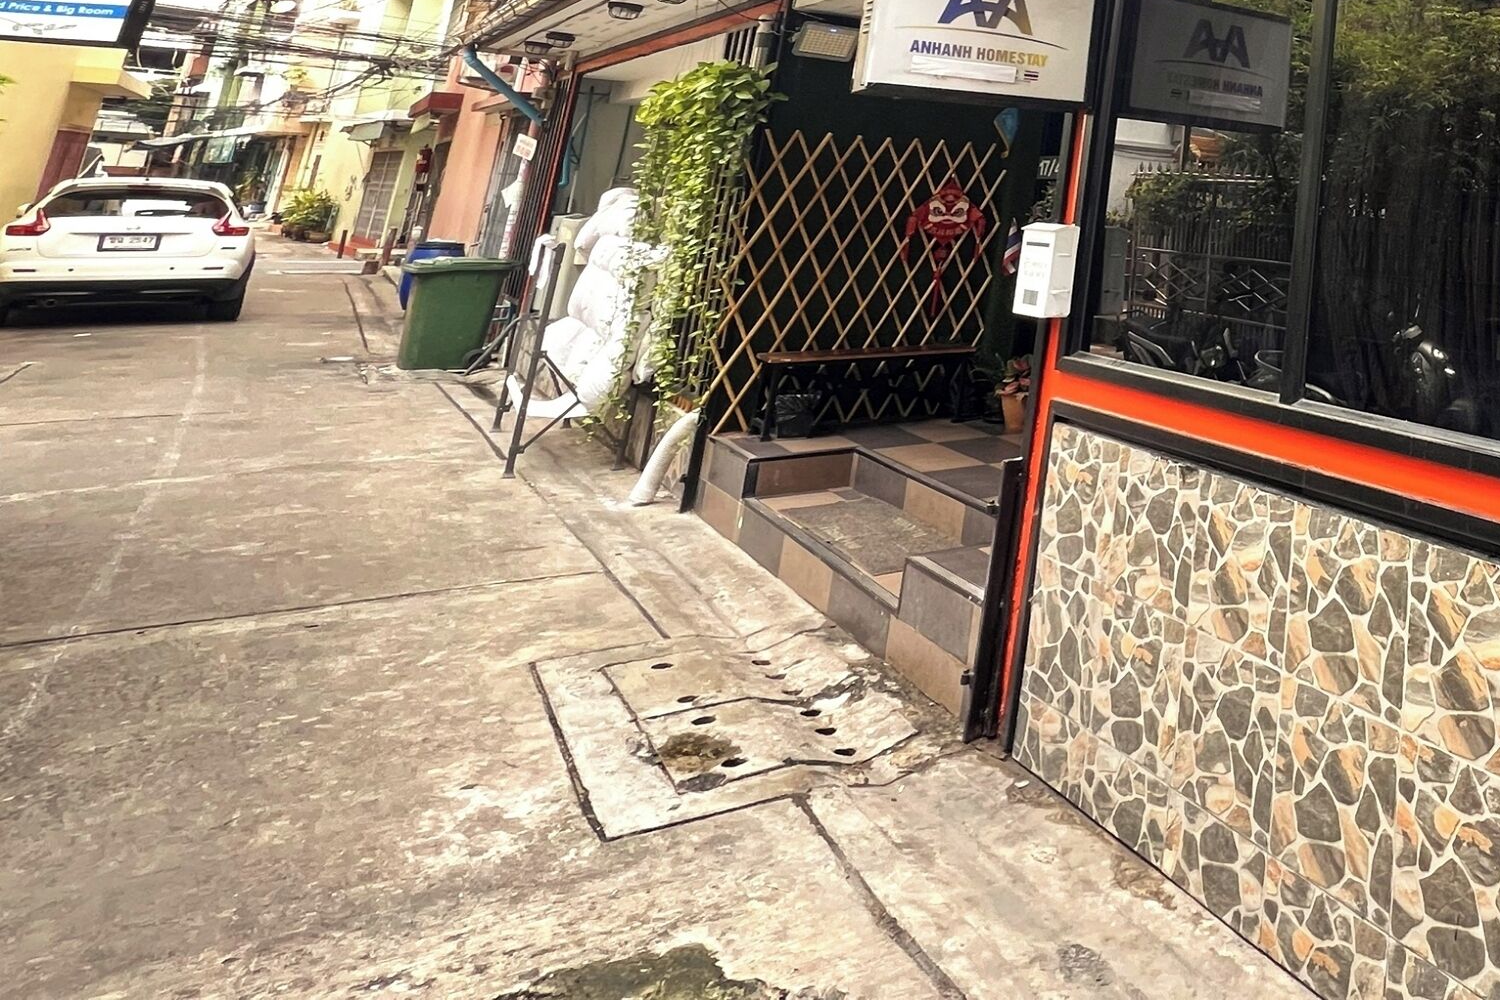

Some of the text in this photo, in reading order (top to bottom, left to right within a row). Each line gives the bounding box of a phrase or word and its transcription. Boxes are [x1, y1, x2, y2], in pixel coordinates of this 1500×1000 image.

[8, 2, 40, 11] Price
[43, 4, 52, 12] &
[78, 6, 114, 16] Room
[910, 39, 1048, 67] ANHANH HOMESTAY
